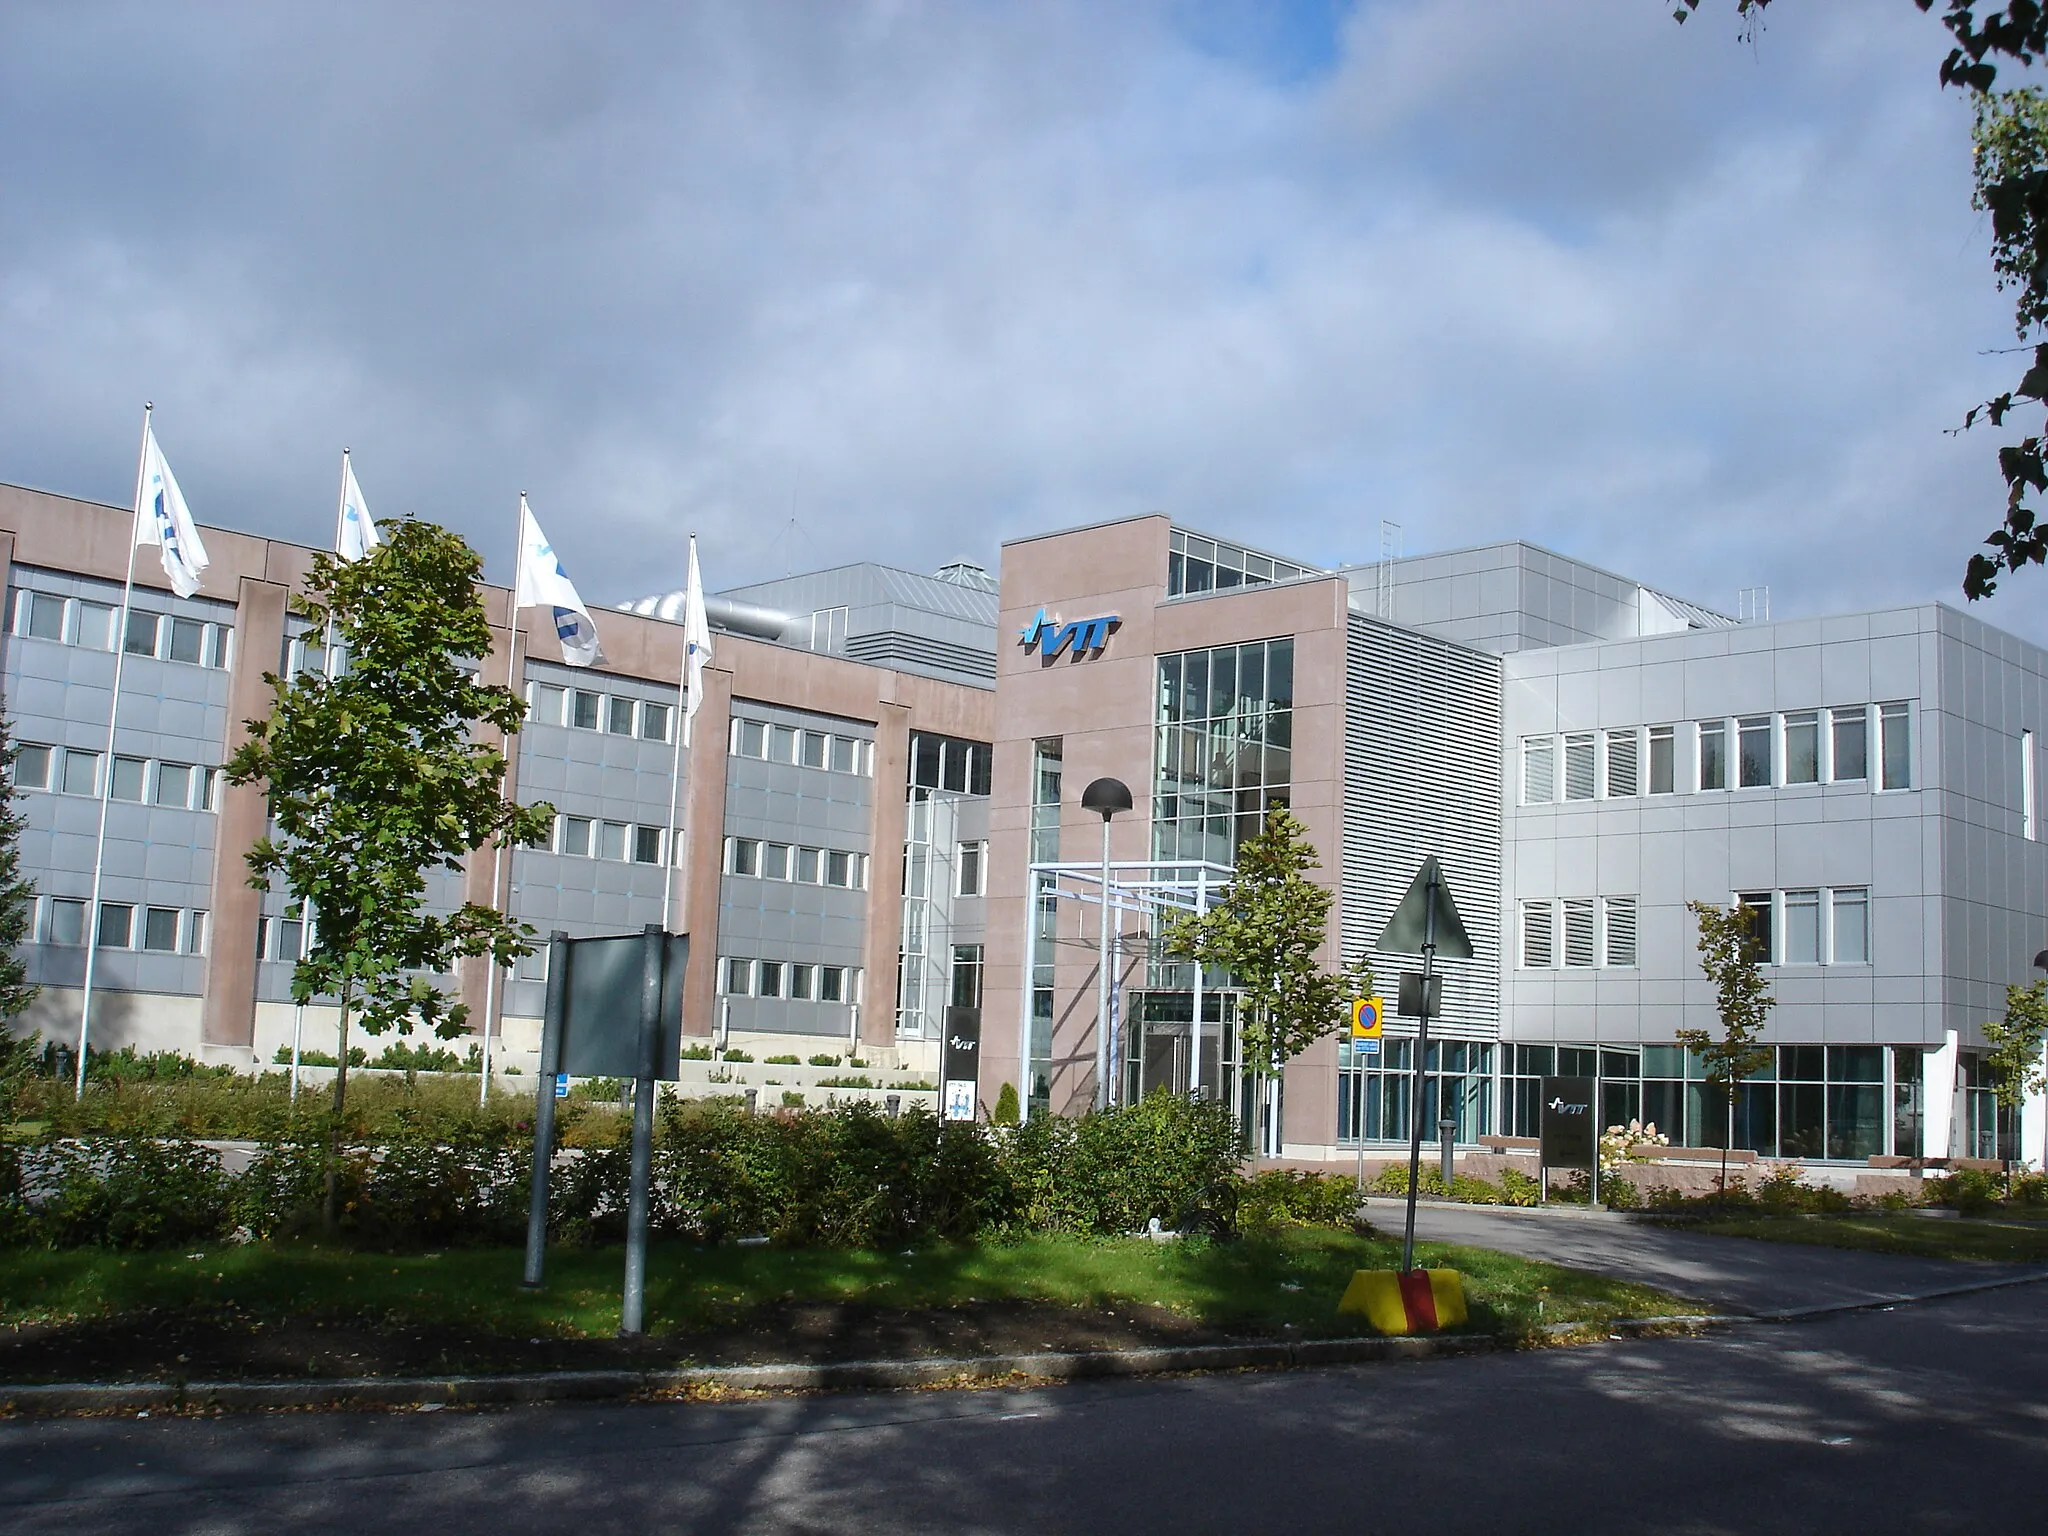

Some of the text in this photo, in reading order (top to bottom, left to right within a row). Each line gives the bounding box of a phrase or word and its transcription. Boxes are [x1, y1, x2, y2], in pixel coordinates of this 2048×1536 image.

[1041, 615, 1120, 657] VTT
[955, 1040, 976, 1051] VTT
[1557, 1103, 1588, 1114] VTT
